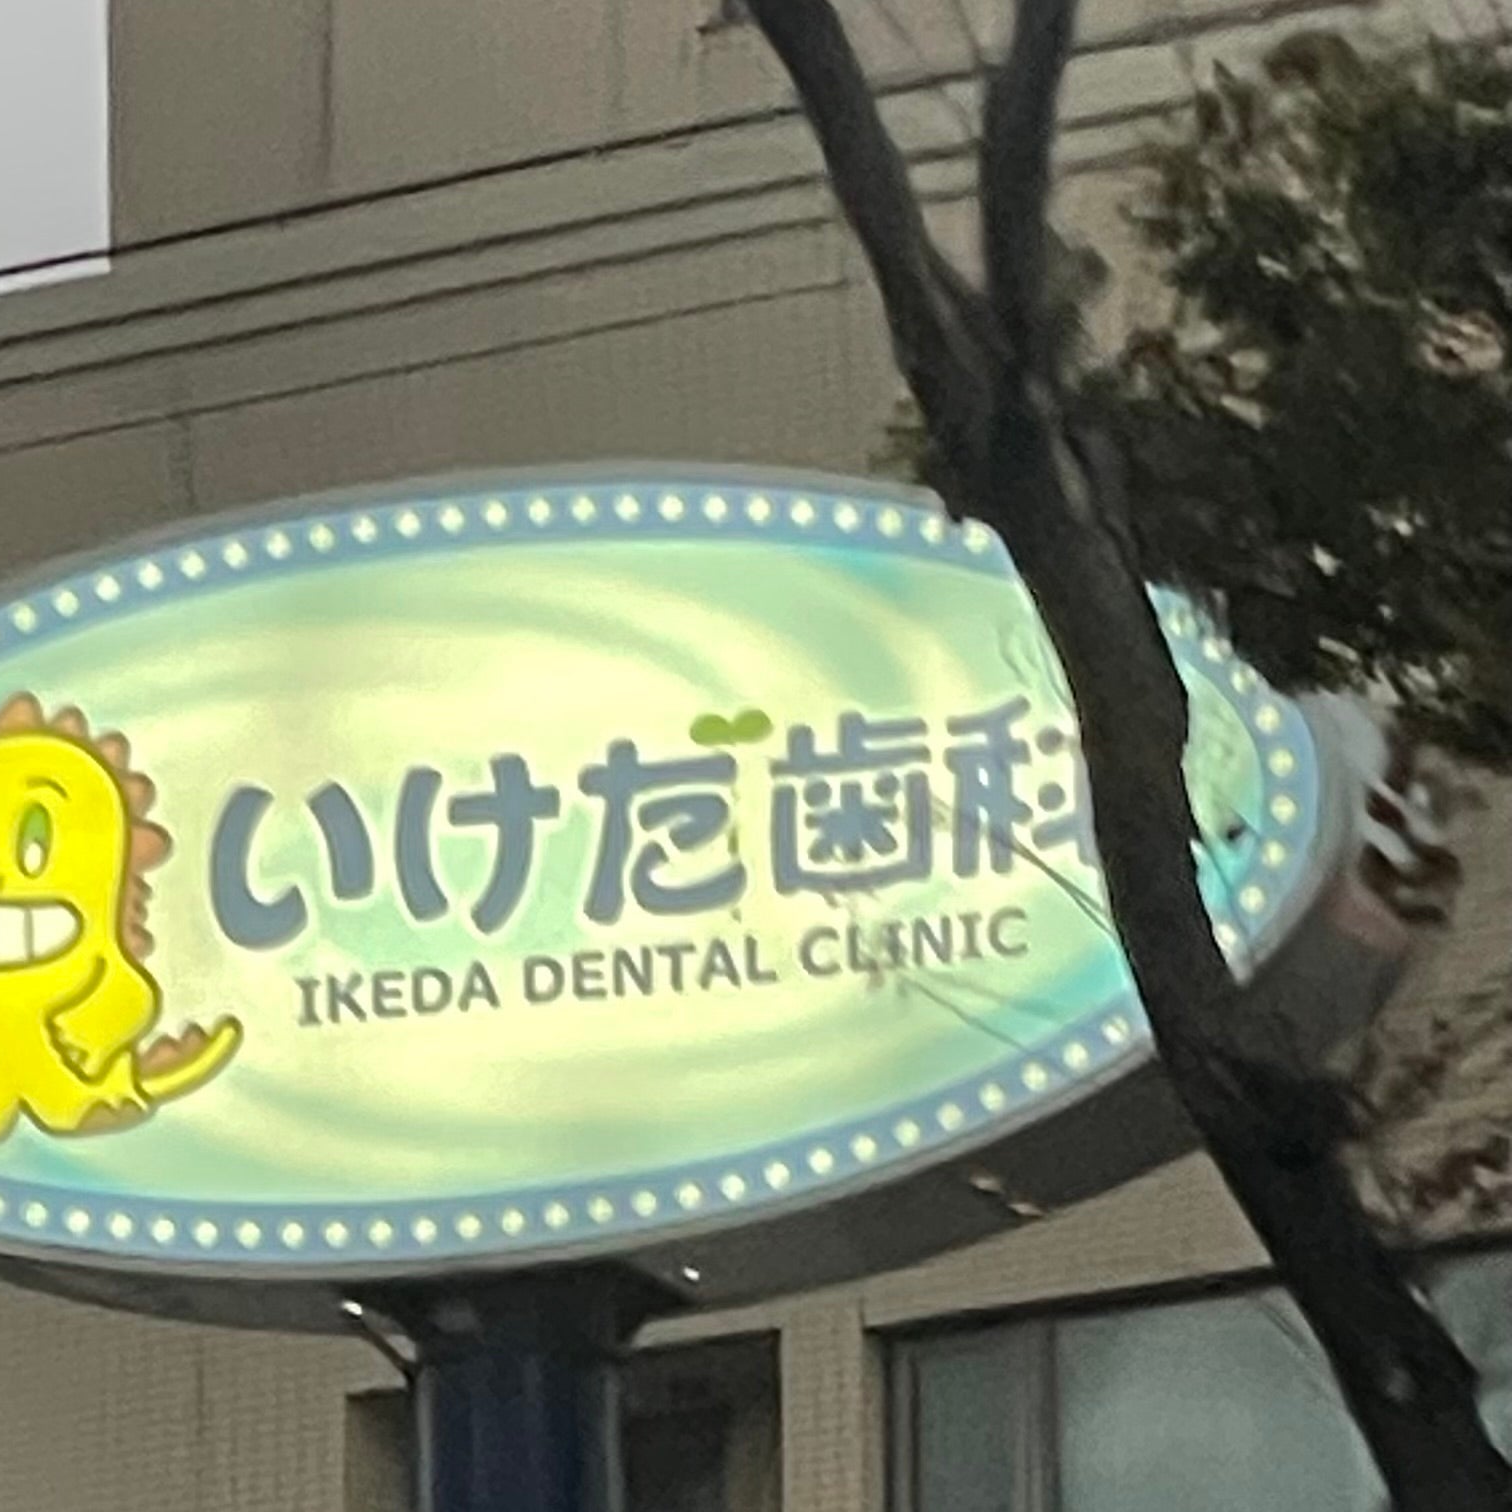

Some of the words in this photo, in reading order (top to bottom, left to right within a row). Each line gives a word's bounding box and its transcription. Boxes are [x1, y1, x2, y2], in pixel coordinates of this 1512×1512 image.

[209, 697, 1098, 951] いけだ歯科
[296, 961, 500, 1027] IKEDA
[522, 932, 778, 1005] DENTAL
[799, 906, 1031, 980] CLINIC
